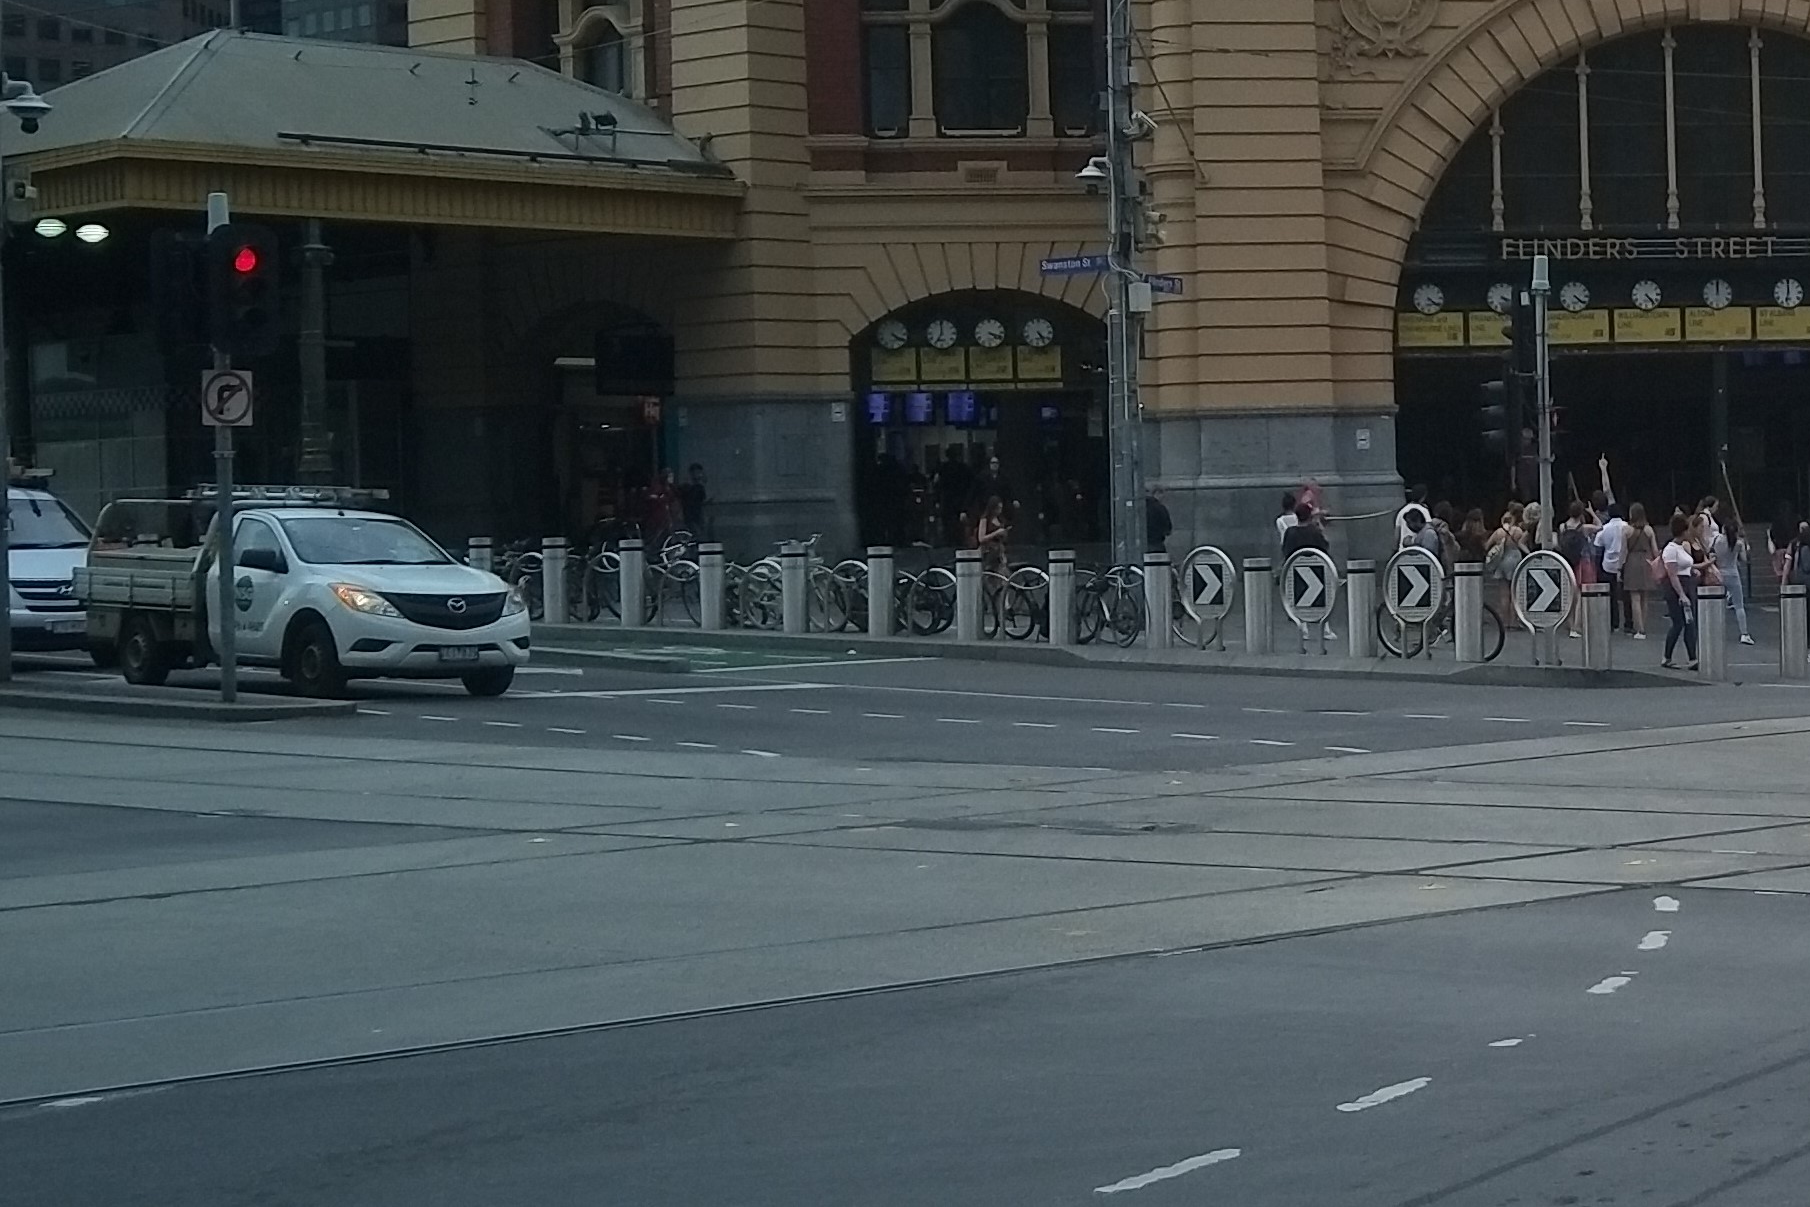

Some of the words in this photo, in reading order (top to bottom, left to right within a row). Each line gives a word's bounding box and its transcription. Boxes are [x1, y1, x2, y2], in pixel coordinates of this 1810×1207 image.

[1501, 238, 1638, 260] FLINDERS
[1675, 237, 1777, 259] STREET
[1041, 259, 1081, 271] Swanston
[1082, 257, 1091, 268] St
[1688, 319, 1704, 327] LINE
